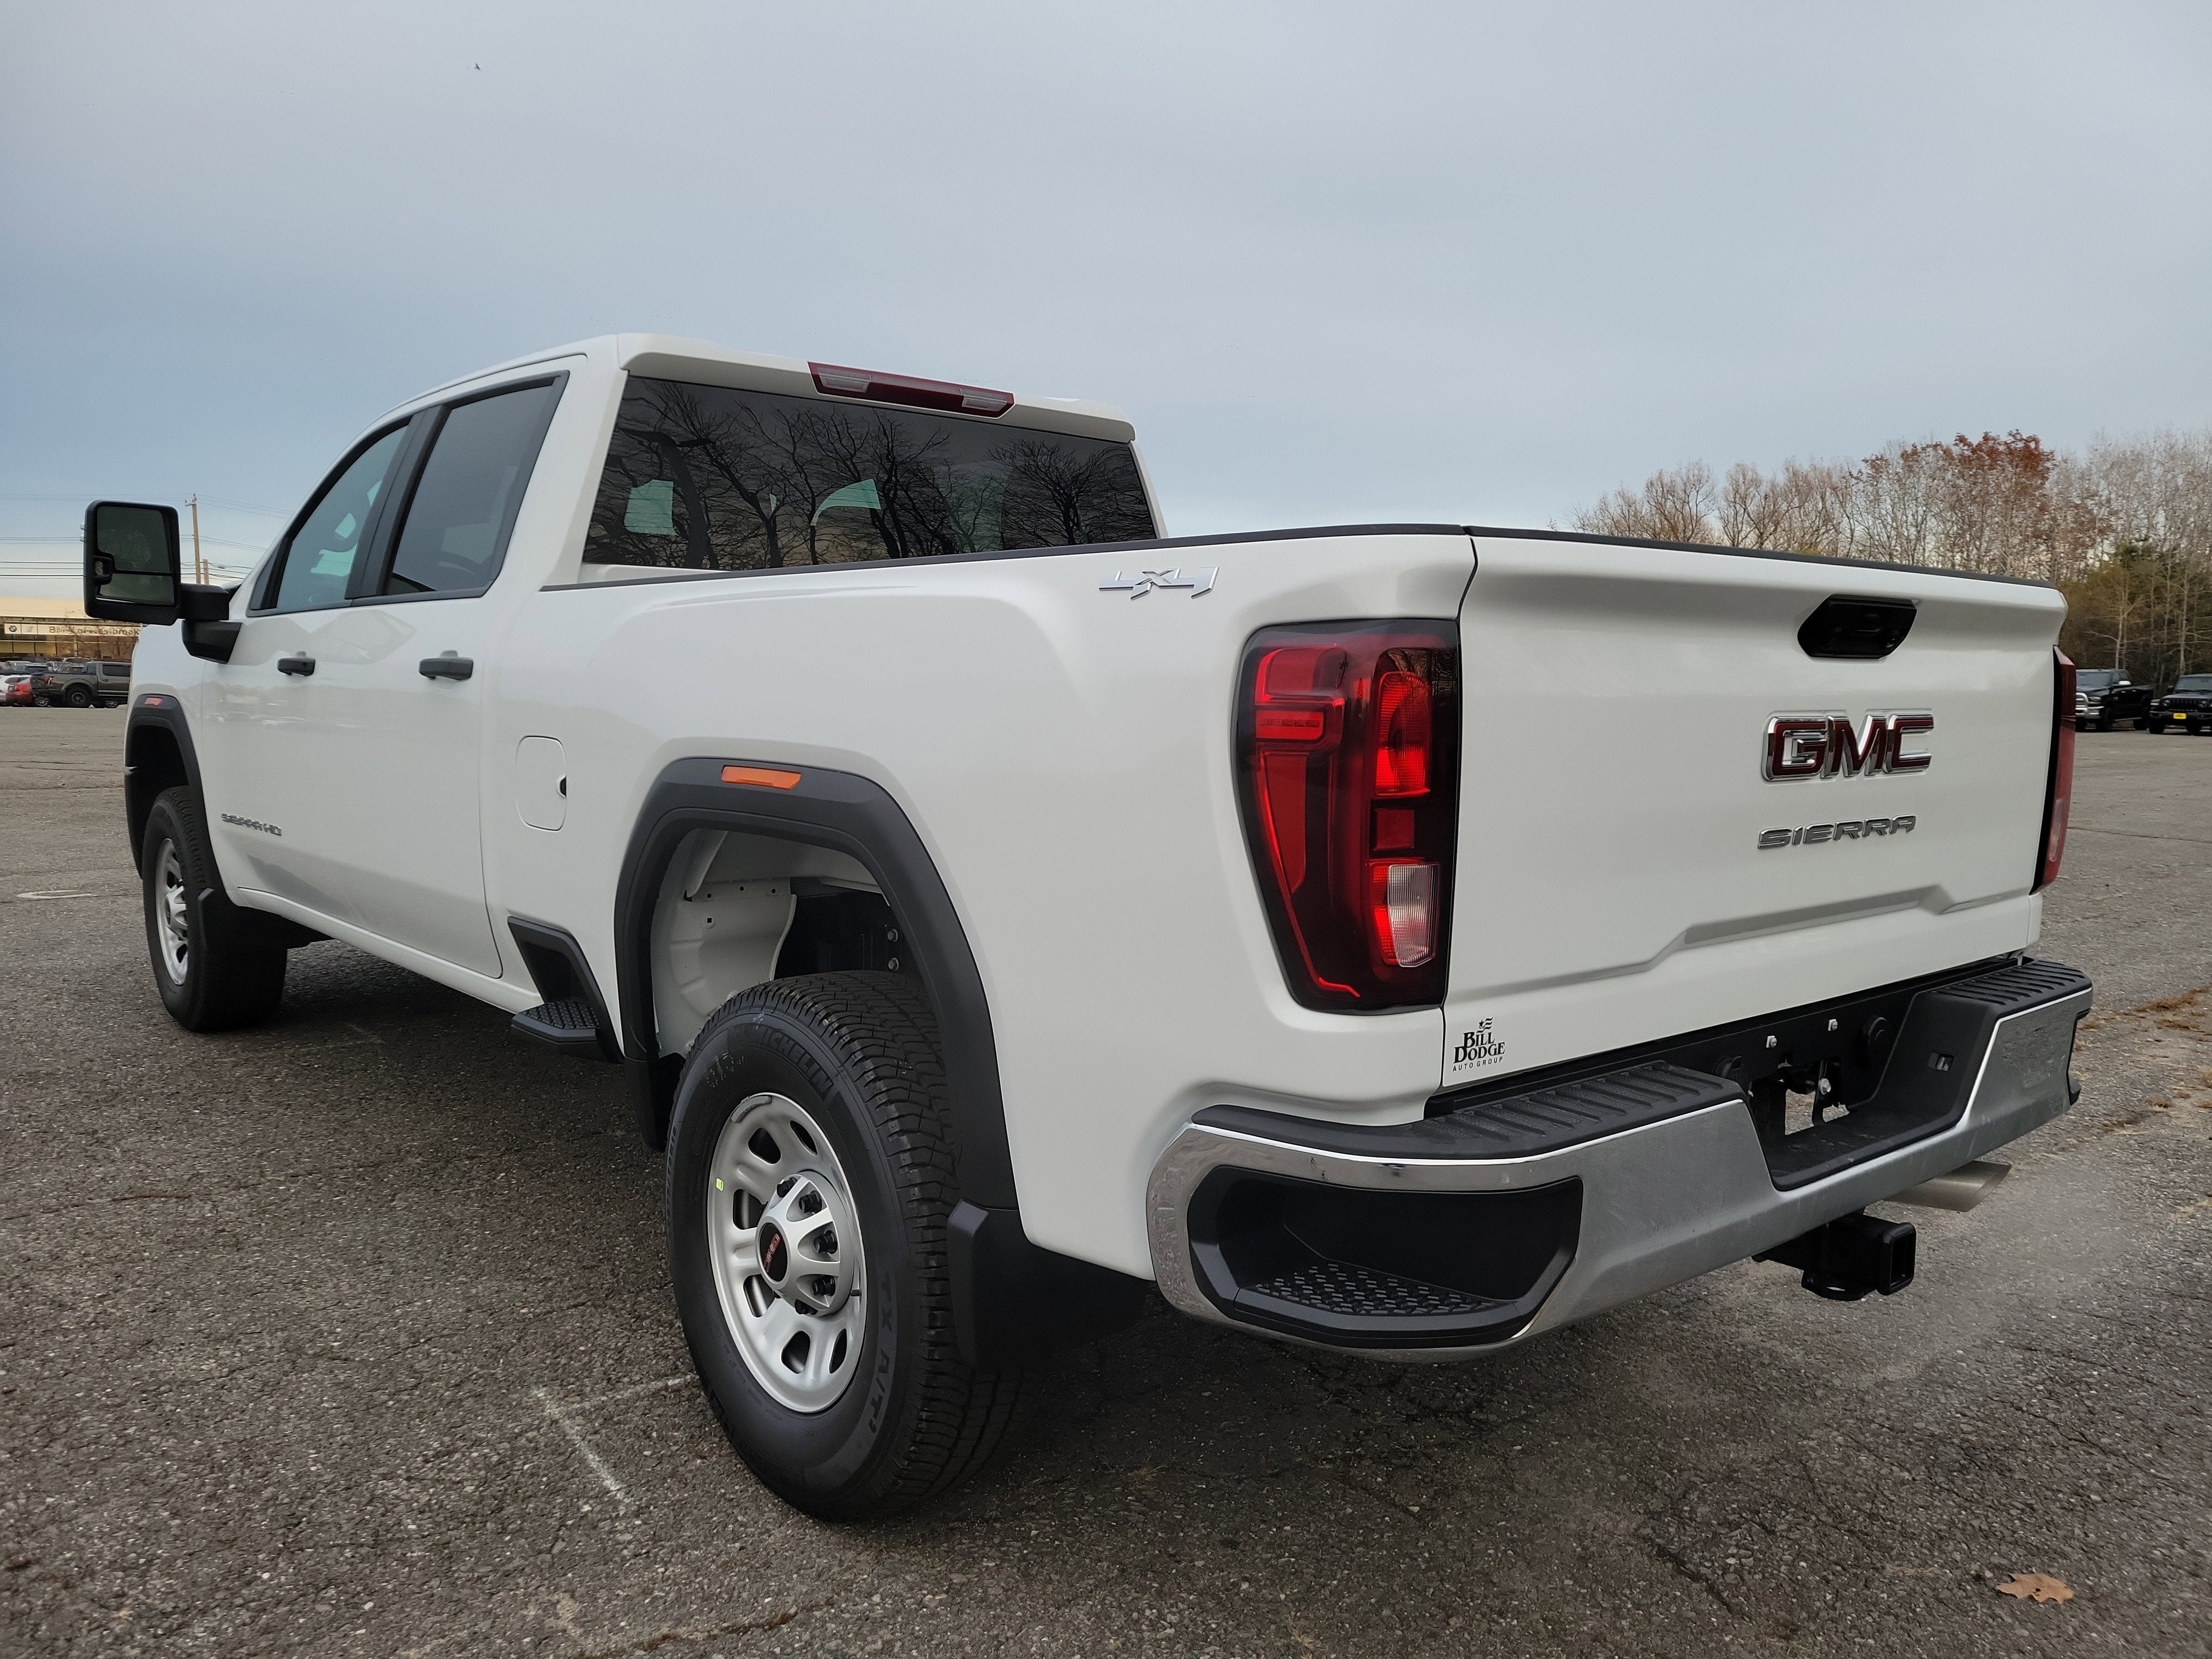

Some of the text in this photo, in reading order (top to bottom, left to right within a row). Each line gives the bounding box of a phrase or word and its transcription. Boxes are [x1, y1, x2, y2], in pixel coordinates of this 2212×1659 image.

[1762, 708, 1934, 781] GMC
[1757, 815, 1916, 850] SIERRA
[1454, 1042, 1505, 1063] DODGE
[1464, 1032, 1495, 1048] BILL
[750, 1024, 834, 1093] MICHELIN
[1453, 1057, 1503, 1071] AUTO GROUP
[764, 1233, 780, 1272] GMC
